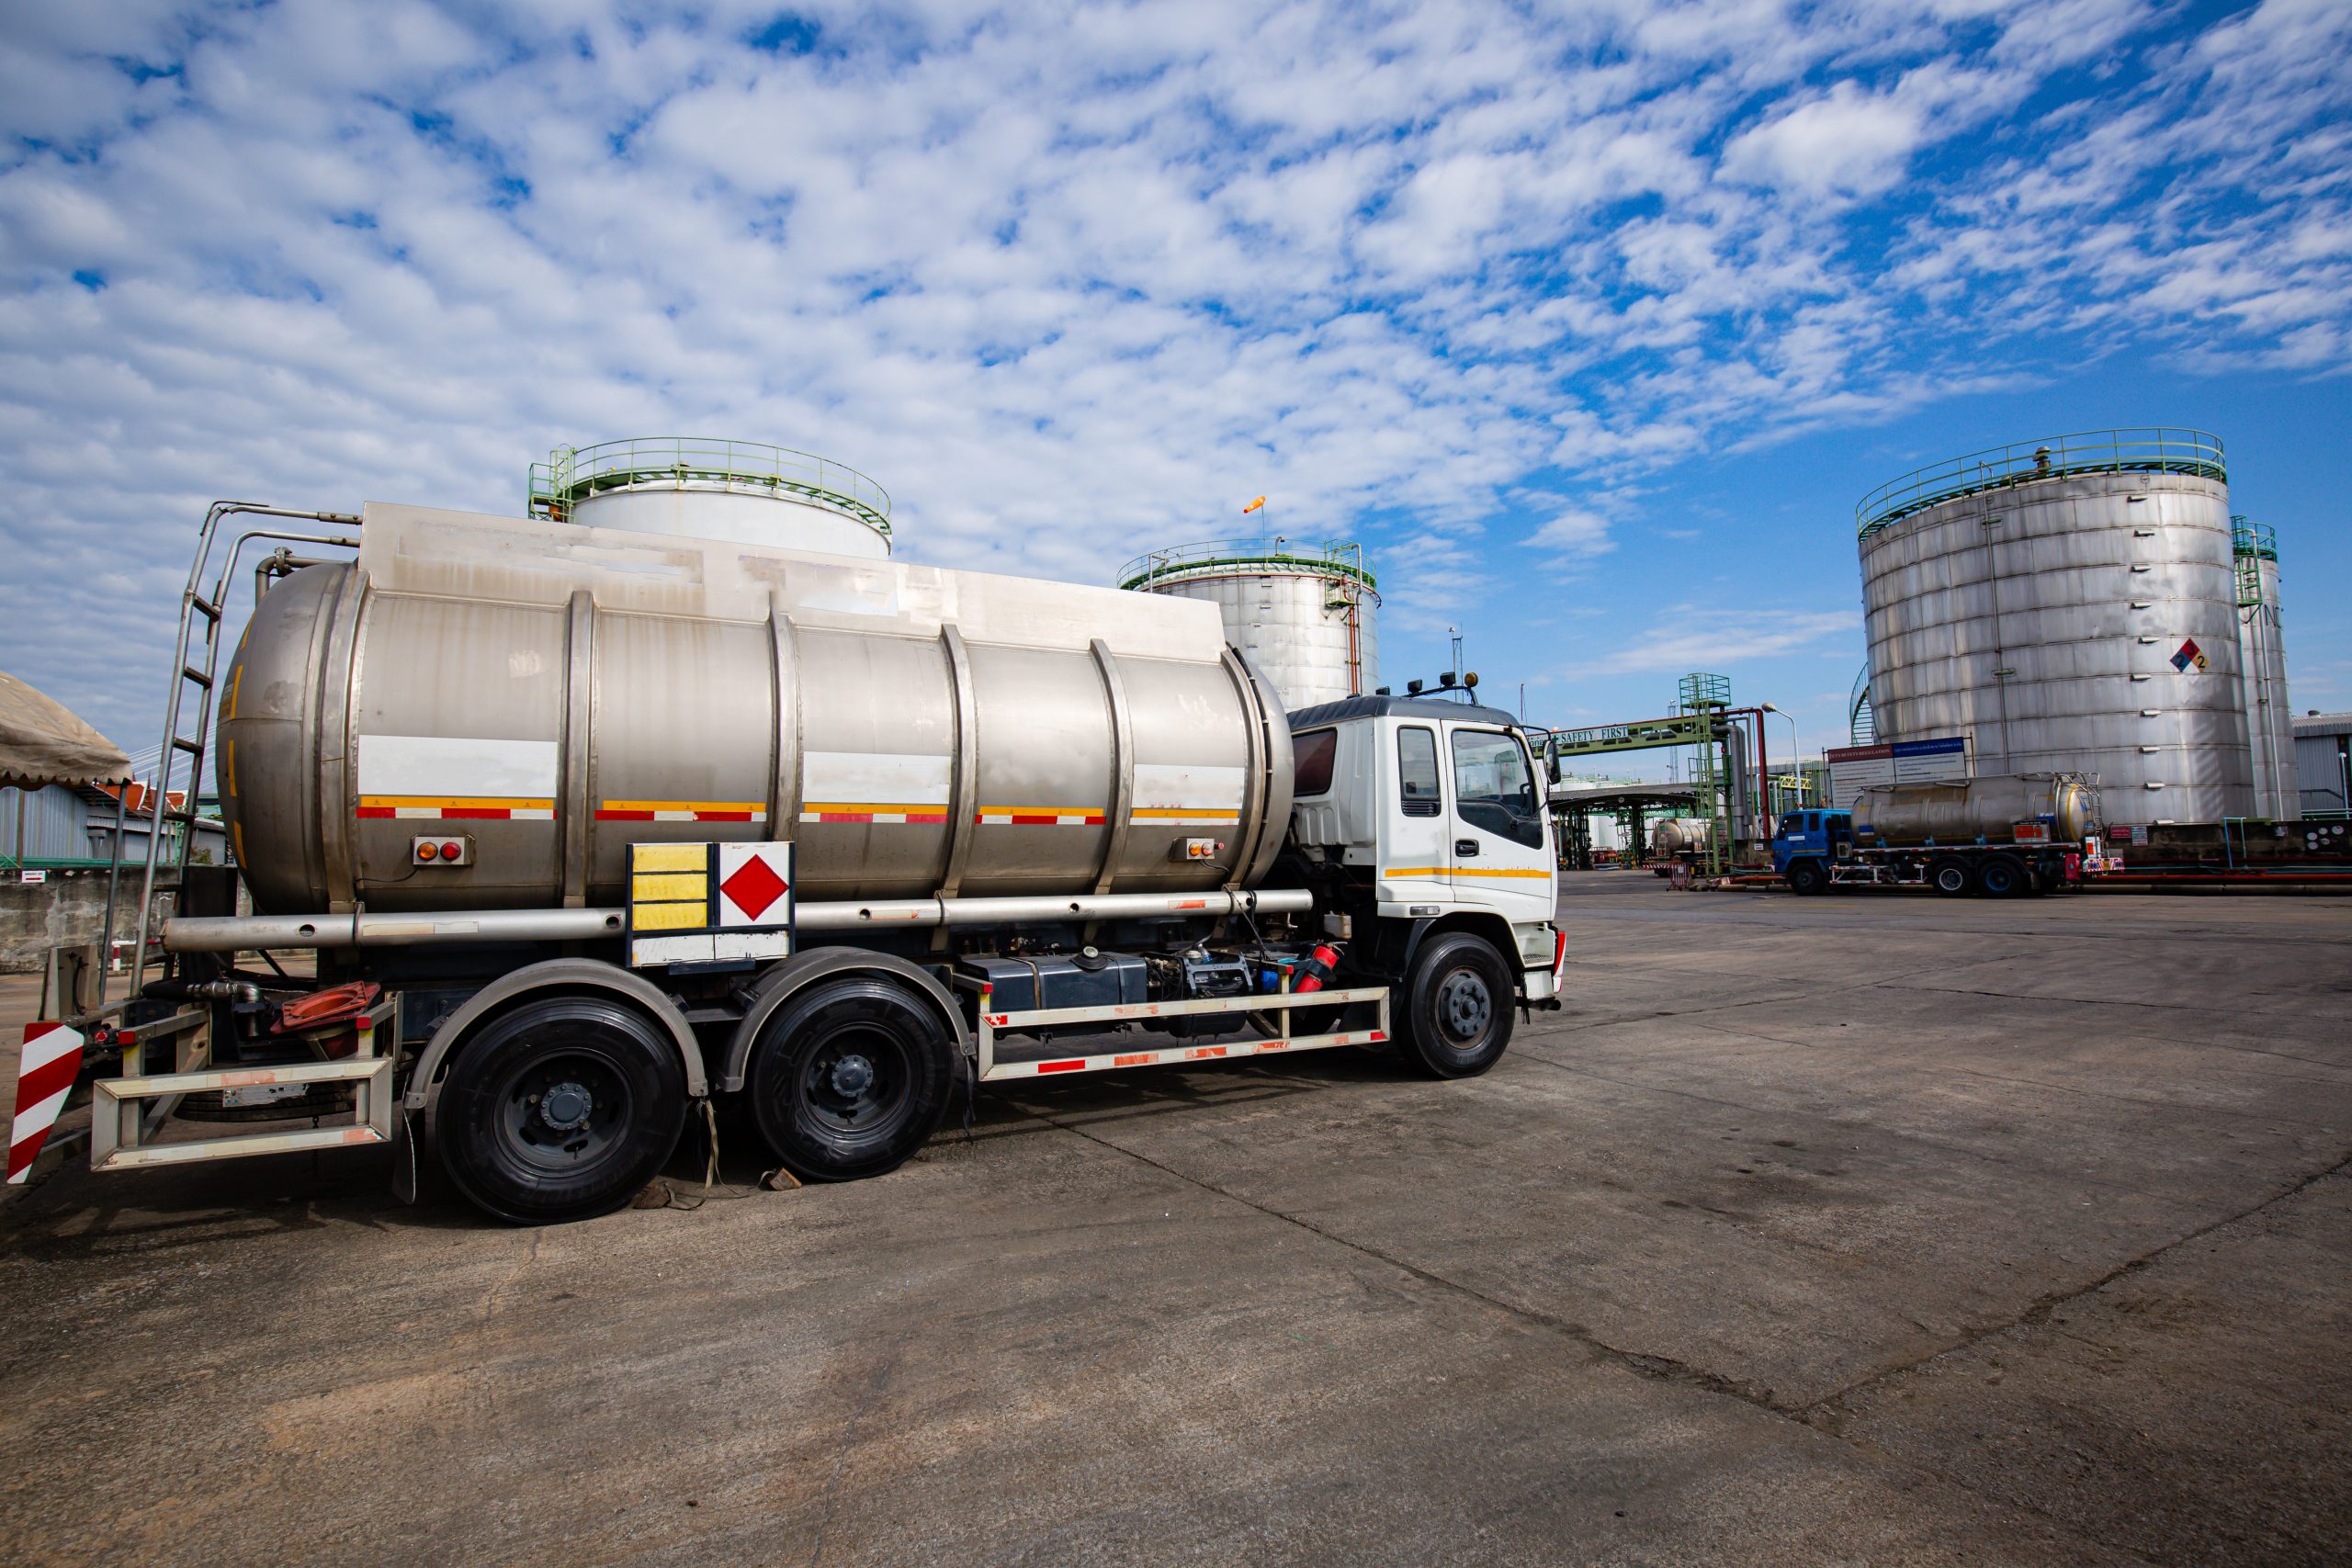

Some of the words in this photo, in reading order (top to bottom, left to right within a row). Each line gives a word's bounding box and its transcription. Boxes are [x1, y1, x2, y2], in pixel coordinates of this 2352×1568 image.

[2188, 643, 2194, 655] 3
[2177, 655, 2184, 667] 2
[2198, 655, 2206, 669] 2
[1561, 729, 1594, 744] SAFETY
[1601, 726, 1627, 739] FIRST
